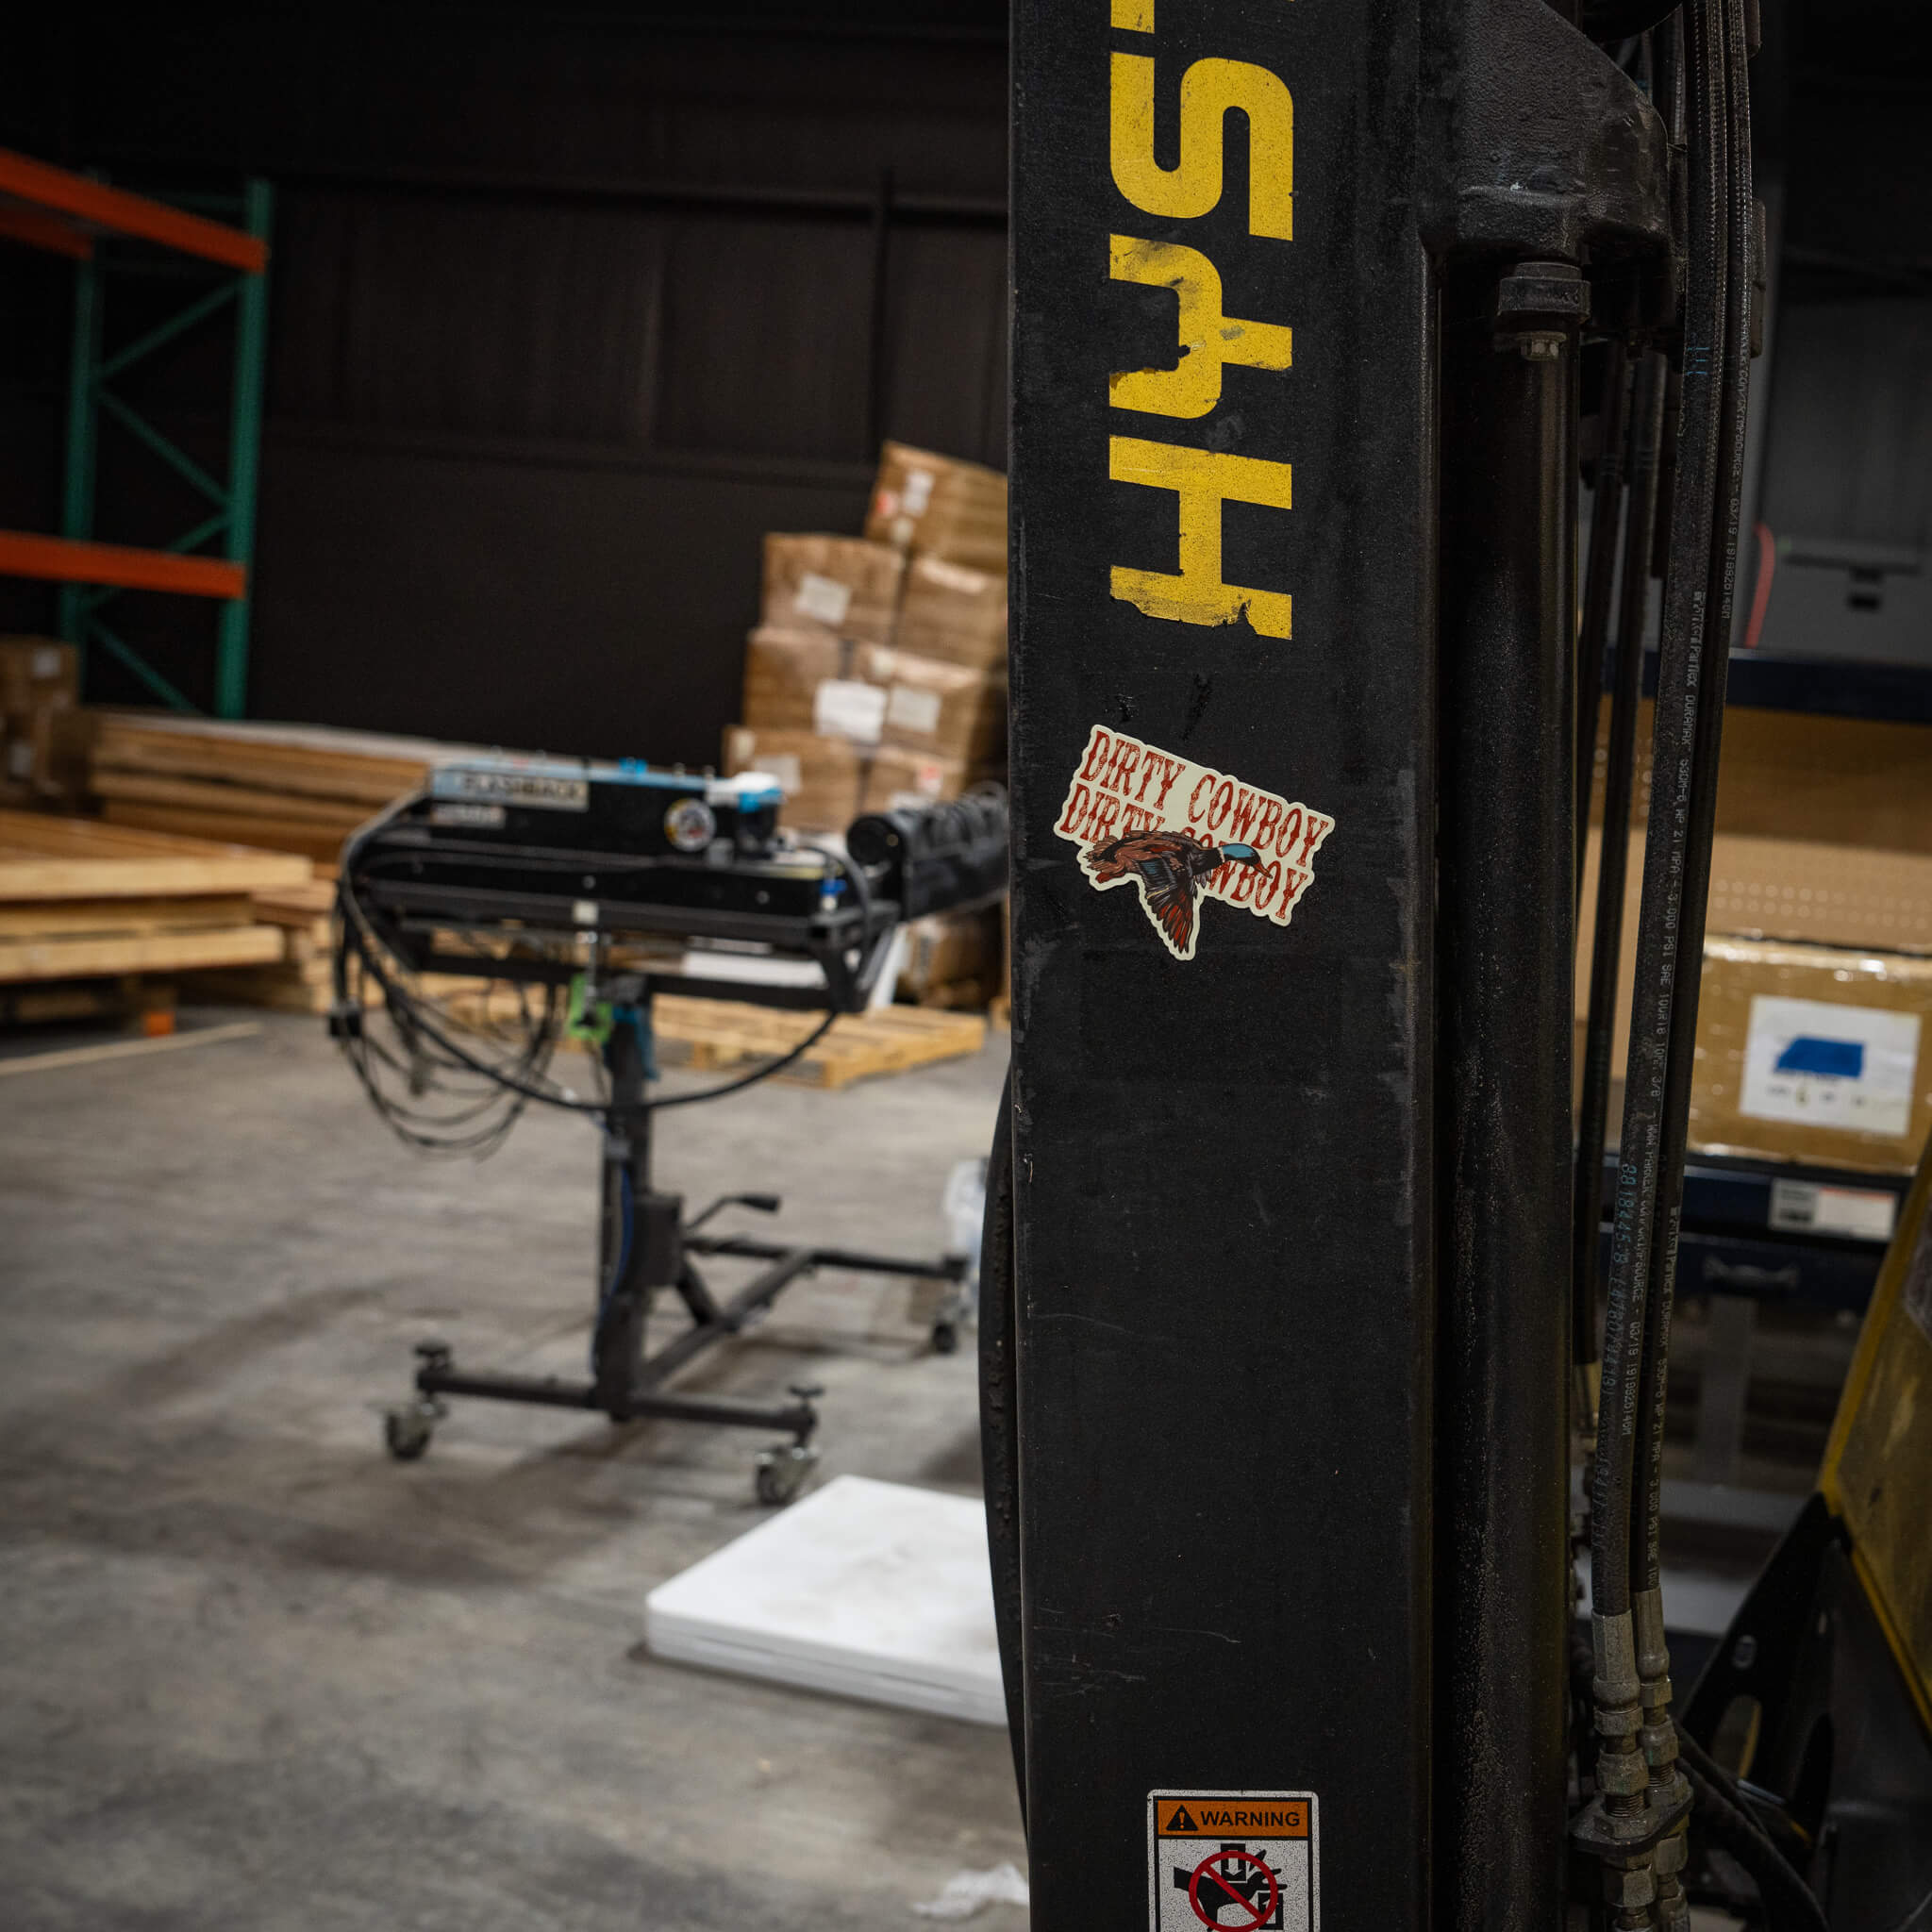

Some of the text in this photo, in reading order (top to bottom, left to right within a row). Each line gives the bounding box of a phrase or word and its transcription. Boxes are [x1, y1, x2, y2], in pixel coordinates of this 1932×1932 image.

[1109, 0, 1293, 641] HYS
[1080, 731, 1328, 867] DIRTY COWBOY
[1200, 1810, 1300, 1827] WARNING
